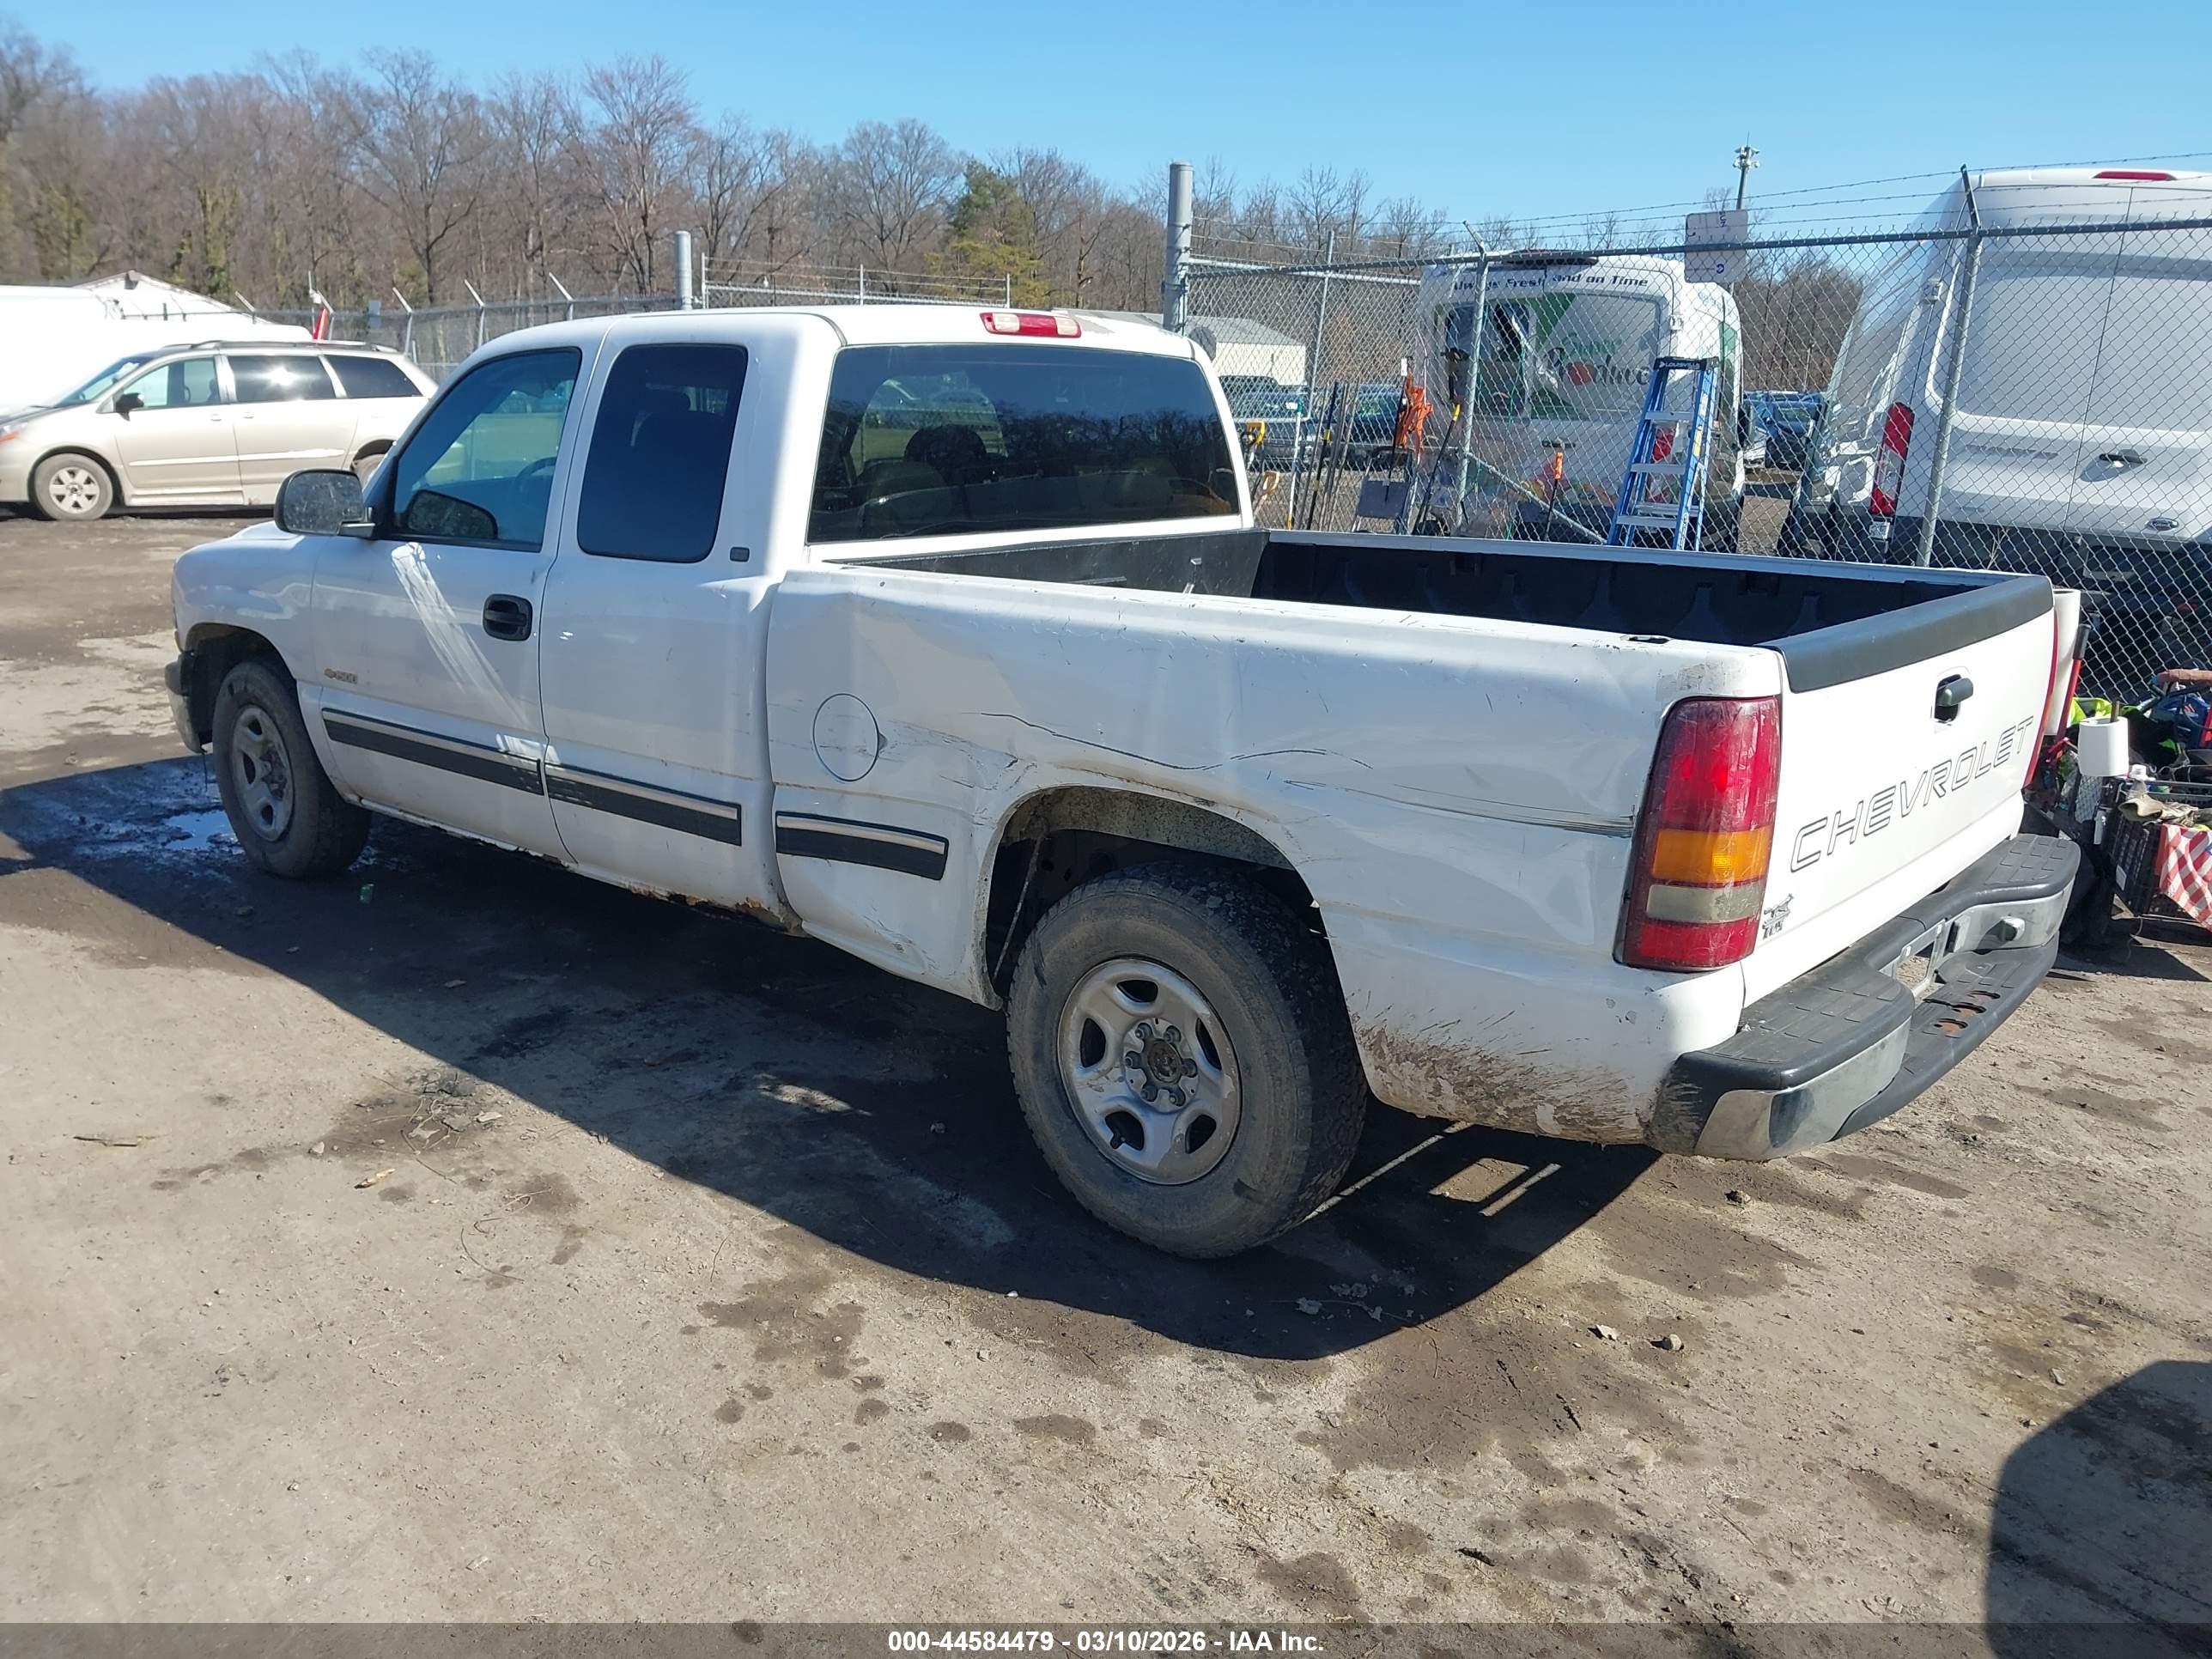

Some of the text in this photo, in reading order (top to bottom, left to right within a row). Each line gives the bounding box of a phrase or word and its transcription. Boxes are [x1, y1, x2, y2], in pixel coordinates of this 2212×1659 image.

[1553, 272, 1582, 283] and
[1586, 275, 1605, 284] on
[1611, 275, 1649, 287] Time
[1790, 715, 2034, 873] CHEVROLET
